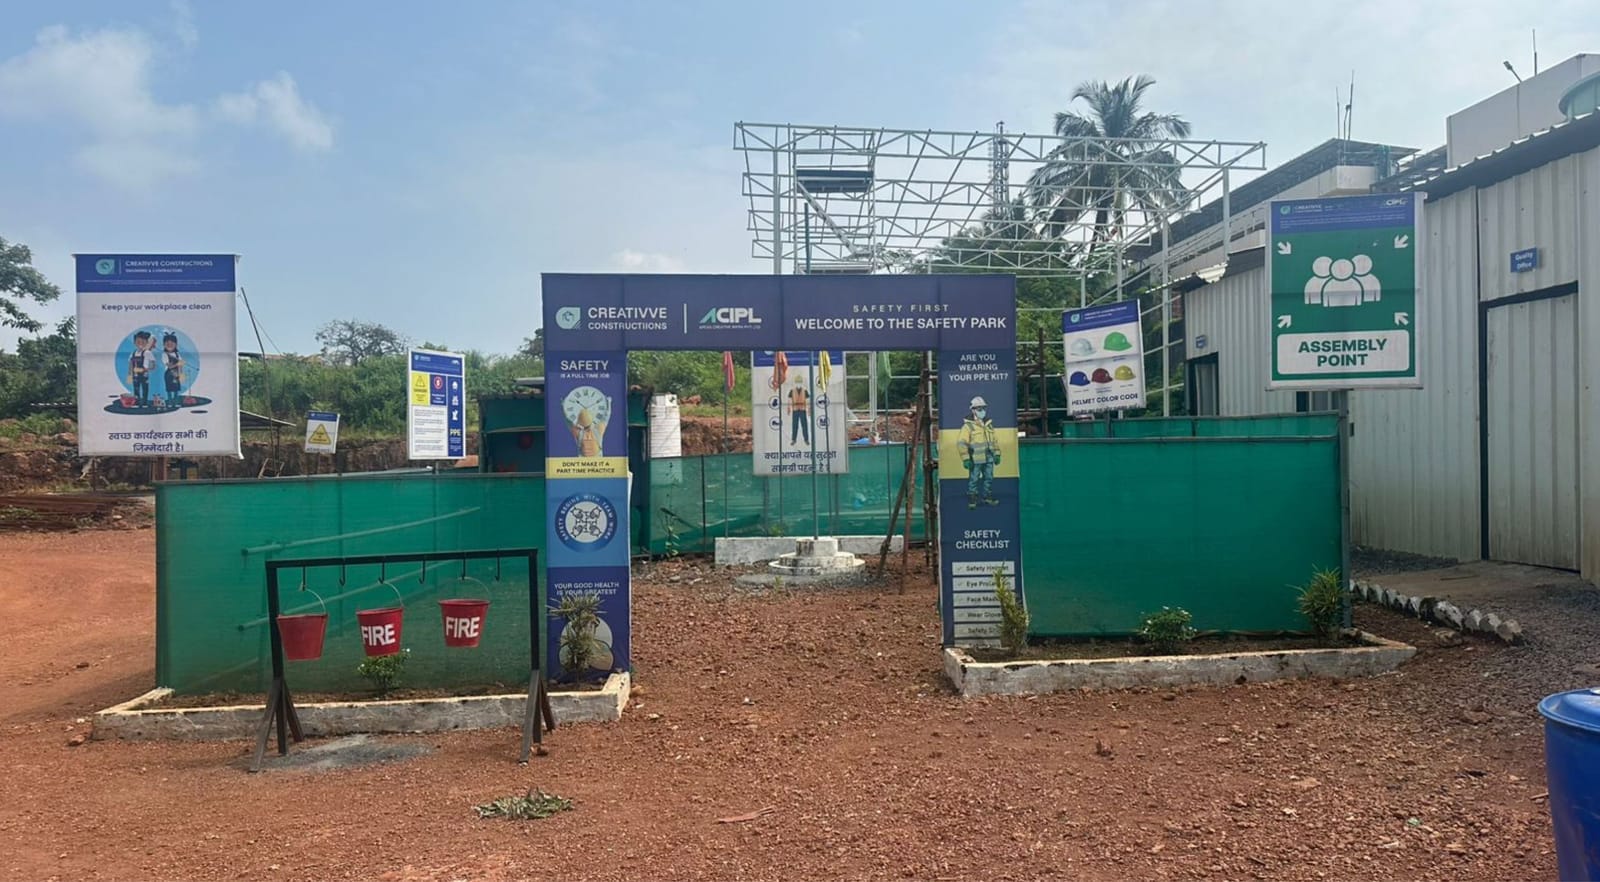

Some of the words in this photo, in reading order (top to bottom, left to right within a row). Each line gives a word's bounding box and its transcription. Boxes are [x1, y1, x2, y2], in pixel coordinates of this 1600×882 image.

[144, 303, 187, 311] workplace
[853, 304, 902, 312] SAFETY
[588, 307, 668, 318] CREATIVVE
[588, 322, 668, 330] CONSTRUCTIIONS
[795, 318, 863, 329] WELCOME
[867, 318, 884, 329] TO
[888, 318, 913, 329] THE
[917, 318, 967, 329] SAFETY
[970, 317, 1006, 328] PARK
[1298, 339, 1387, 353] ASSEMBLY
[561, 360, 609, 370] SAFETY
[1317, 354, 1368, 367] POINT
[175, 430, 194, 440] सभी
[195, 429, 208, 439] की
[133, 442, 173, 452] जिम्मेदारी
[964, 530, 1000, 539] SAFETY
[955, 540, 1010, 549] CHECKLIST
[446, 617, 480, 638] FIRE
[361, 624, 395, 646] FIRE
